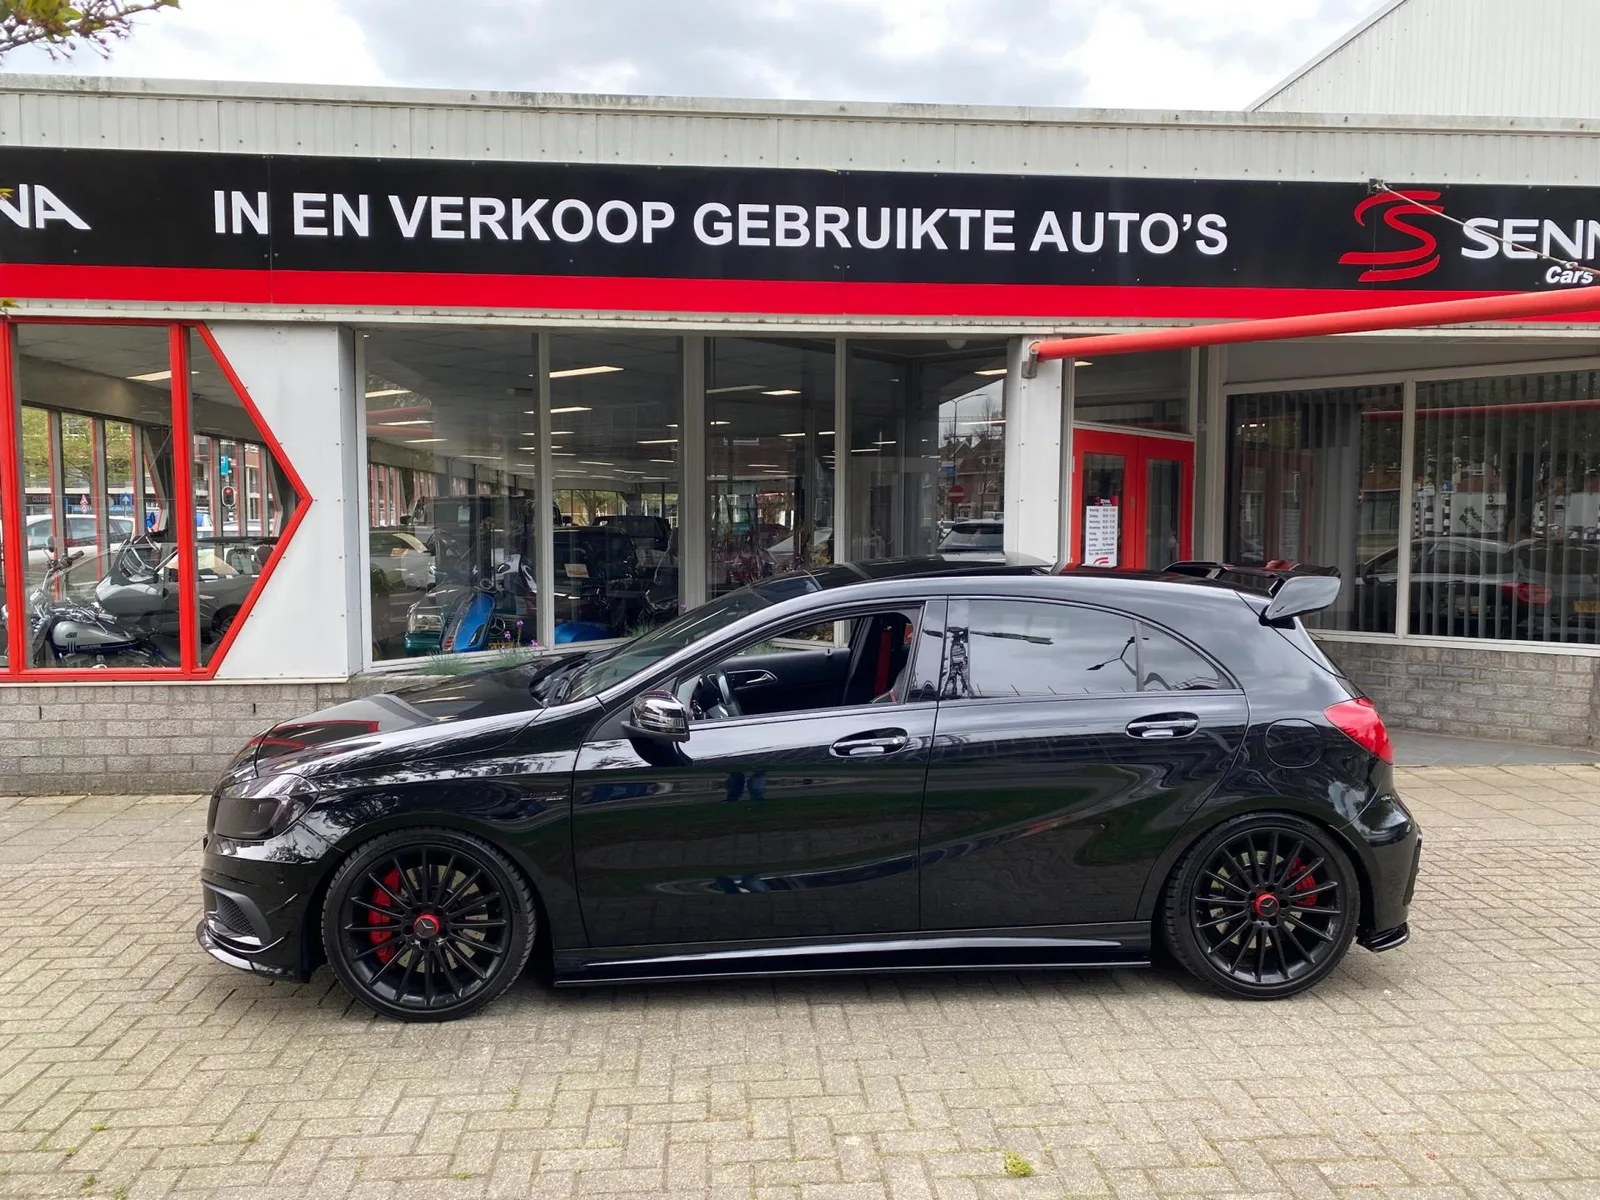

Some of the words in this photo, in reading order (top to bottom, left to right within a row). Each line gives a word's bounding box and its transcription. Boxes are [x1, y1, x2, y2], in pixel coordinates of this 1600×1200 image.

[214, 191, 268, 235] IN
[293, 193, 369, 237] EN
[388, 195, 675, 244] VERKOOP
[694, 202, 1015, 252] GEBRUIKTE
[1030, 211, 1227, 256] AUTO’S
[1545, 265, 1594, 284] Cars
